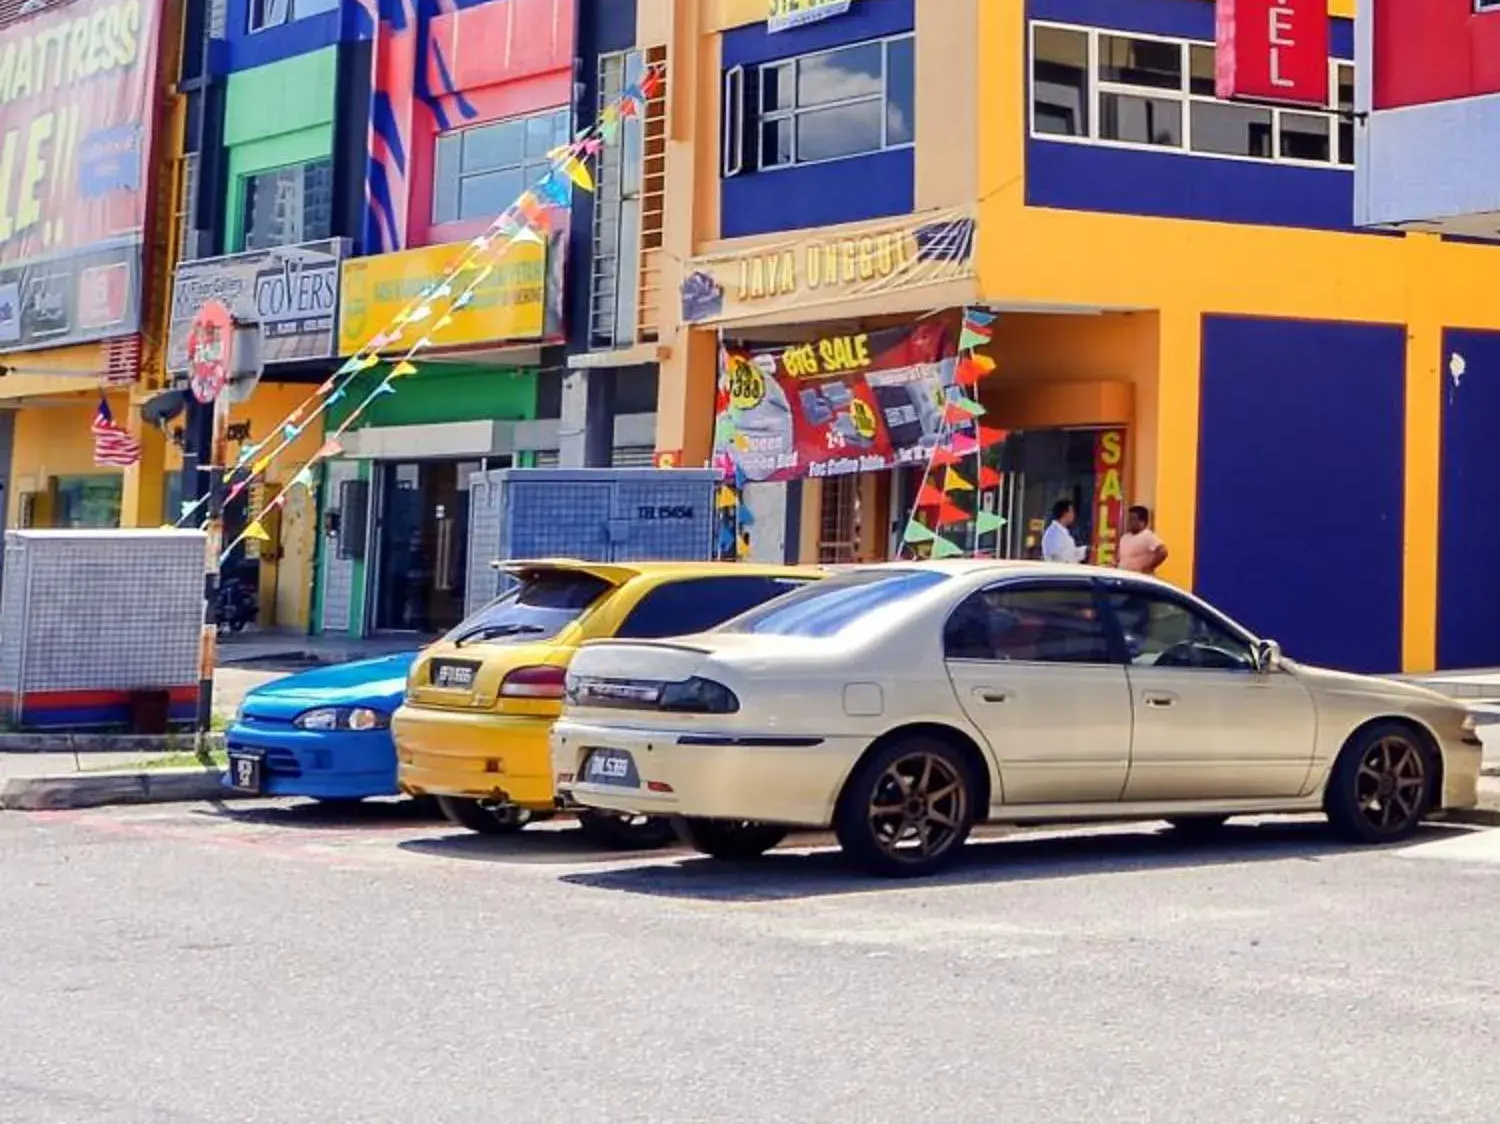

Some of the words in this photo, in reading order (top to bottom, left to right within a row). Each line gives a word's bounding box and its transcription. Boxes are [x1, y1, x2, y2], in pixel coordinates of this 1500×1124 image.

[257, 252, 336, 317] COVERS
[737, 249, 796, 301] JAYA
[783, 345, 819, 378] BIG
[819, 332, 871, 372] SALE
